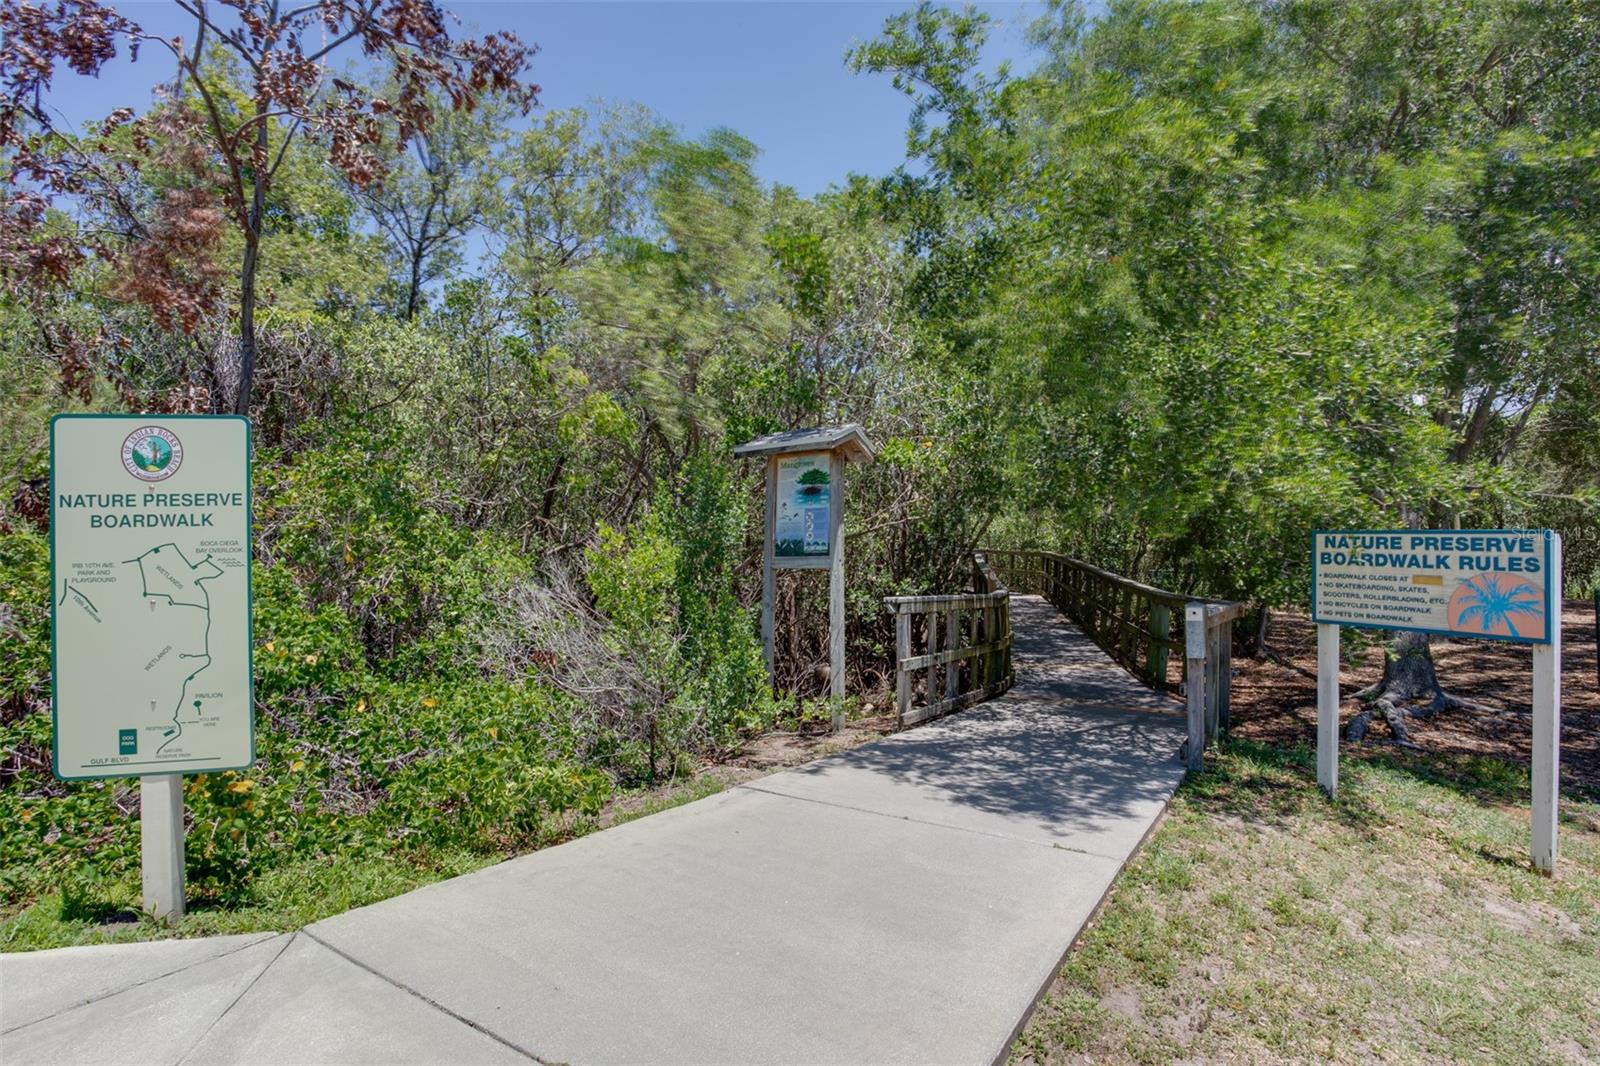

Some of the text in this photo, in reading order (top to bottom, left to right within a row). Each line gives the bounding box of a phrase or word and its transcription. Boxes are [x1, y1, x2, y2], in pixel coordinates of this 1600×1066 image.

[158, 429, 178, 448] ROCKS
[59, 492, 242, 508] NATURE PRESERVE
[90, 513, 214, 528] BOARDWALK
[1324, 535, 1535, 553] NATURE PRESERVE
[1320, 552, 1541, 573] BOARDWALK RULES
[156, 564, 184, 590] WETLANDS
[1323, 572, 1367, 580] BOARDWALK
[1335, 582, 1396, 592] SKATEBOARDING,
[1323, 591, 1362, 600] SCOOTERS,
[1363, 594, 1427, 604] ROLLERBLADING,
[1383, 605, 1432, 614] BOARDWALK
[1366, 614, 1413, 622] BOARDWALK
[144, 644, 172, 672] WETLANDS
